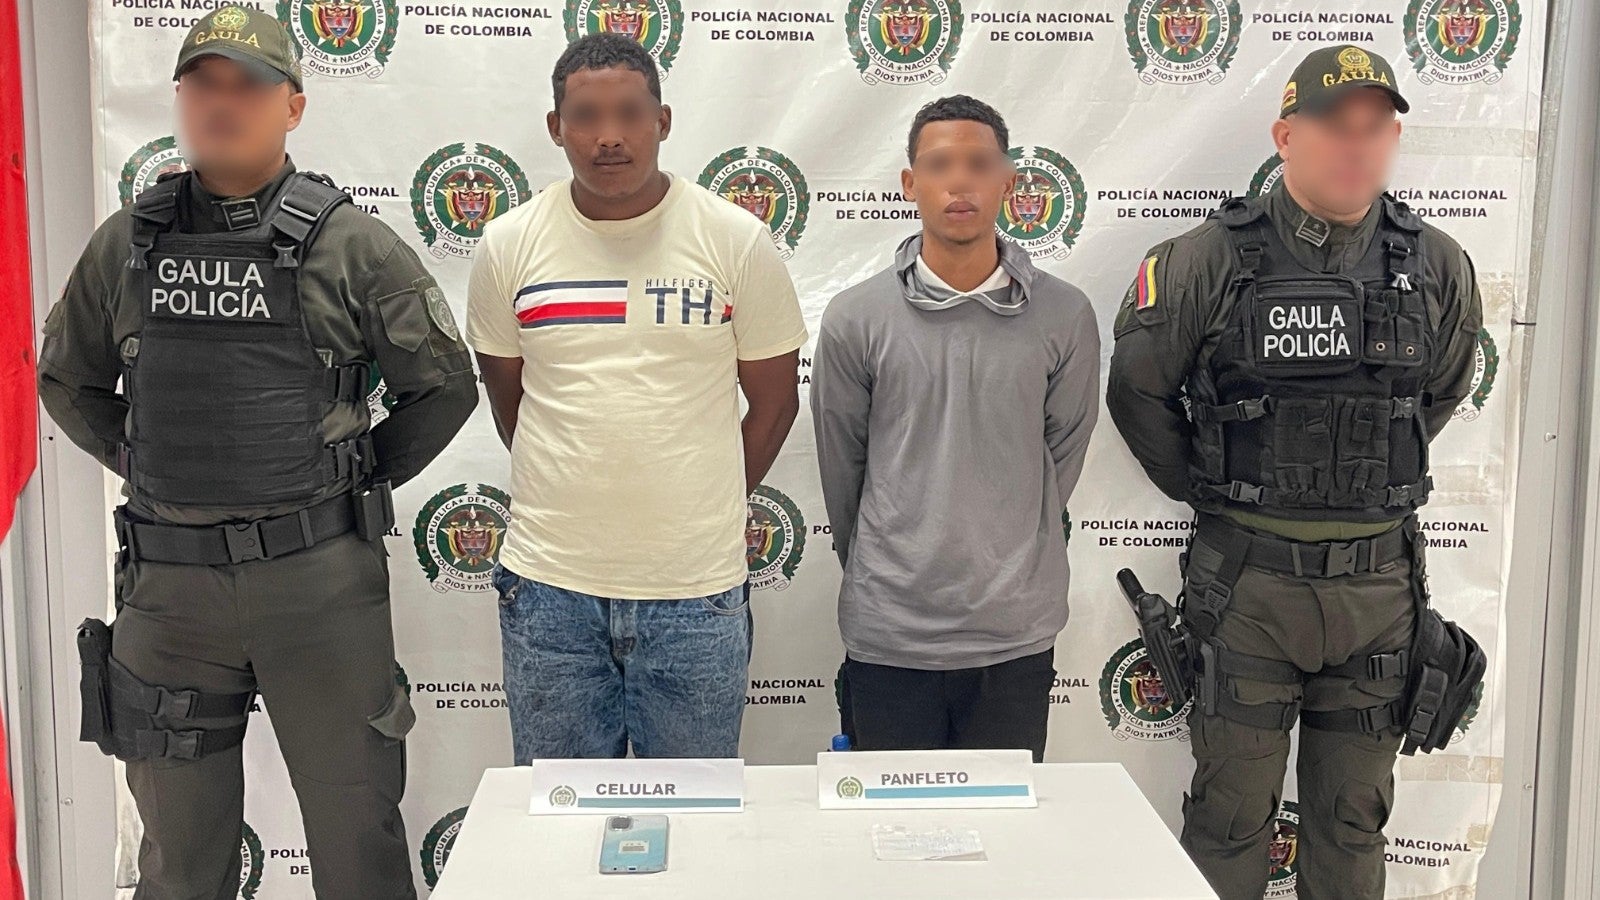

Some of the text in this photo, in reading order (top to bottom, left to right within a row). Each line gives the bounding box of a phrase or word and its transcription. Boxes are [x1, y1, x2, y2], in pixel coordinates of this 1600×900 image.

[405, 4, 552, 18] POLICÍA NACIONAL
[692, 9, 834, 22] POLICÍA NACIONAL
[972, 11, 1114, 23] POLICÍA NACIONAL
[1253, 11, 1393, 23] POLICÍA NACIONAL
[134, 17, 199, 27] DE COLO
[426, 25, 532, 36] DE COLOMBIA
[712, 30, 814, 41] DE COLOMBIA
[991, 32, 1093, 41] DE COLOMBIA
[1273, 31, 1373, 41] DE COLOMBIA
[196, 31, 261, 48] GAULA
[340, 36, 380, 63] NACIONAL
[904, 44, 945, 71] NACIONAL
[1183, 44, 1224, 70] NACIONAL
[1459, 43, 1502, 71] NACIONAL
[340, 62, 371, 74] PATRIA
[904, 69, 934, 82] PATRIA
[1182, 69, 1212, 82] PATRIA
[1322, 71, 1390, 87] GAULA
[1458, 68, 1490, 82] PATRIA
[134, 154, 167, 193] EPUBLICA
[426, 160, 456, 207] REPUBLICA
[488, 162, 517, 208] COLOMBIA
[711, 164, 738, 192] UBLICA
[770, 165, 795, 210] COLOMBIA
[1046, 165, 1072, 210] COLOMBIA
[342, 186, 399, 197] CIONAL
[817, 190, 876, 201] POLICÍA
[1098, 188, 1158, 200] POLICÍA
[1429, 190, 1507, 199] NACIONAL
[837, 210, 855, 219] DE
[1118, 209, 1136, 217] DE
[1410, 208, 1488, 218] OLOMBIA
[1028, 220, 1068, 247] NACIONAL
[159, 259, 264, 287] GAULA
[646, 279, 712, 288] HILFIGER
[152, 289, 270, 318] POLICÍA
[646, 288, 712, 324] TH
[1269, 305, 1345, 329] GAULA
[1264, 328, 1350, 357] POLICÍA
[429, 500, 458, 545] REPUBLICA
[766, 500, 792, 544] COLOMBIA
[1082, 519, 1138, 529] POLICÍA
[1100, 537, 1188, 547] DE COLOMBI
[750, 553, 787, 578] NACIONAL
[1112, 652, 1141, 694] REPUBLICA
[417, 682, 476, 692] POLICÍA
[752, 679, 824, 689] NACIONAL
[437, 700, 455, 708] DE
[744, 696, 806, 704] OLOMBIA
[1154, 704, 1193, 728] NACIONAL
[1154, 727, 1182, 738] PATRIA
[881, 772, 968, 785] PANFLETO
[596, 784, 676, 795] CELULAR
[1395, 838, 1472, 852] NACIONAL
[1384, 853, 1450, 867] OLOMBIA
[290, 866, 310, 875] DE
